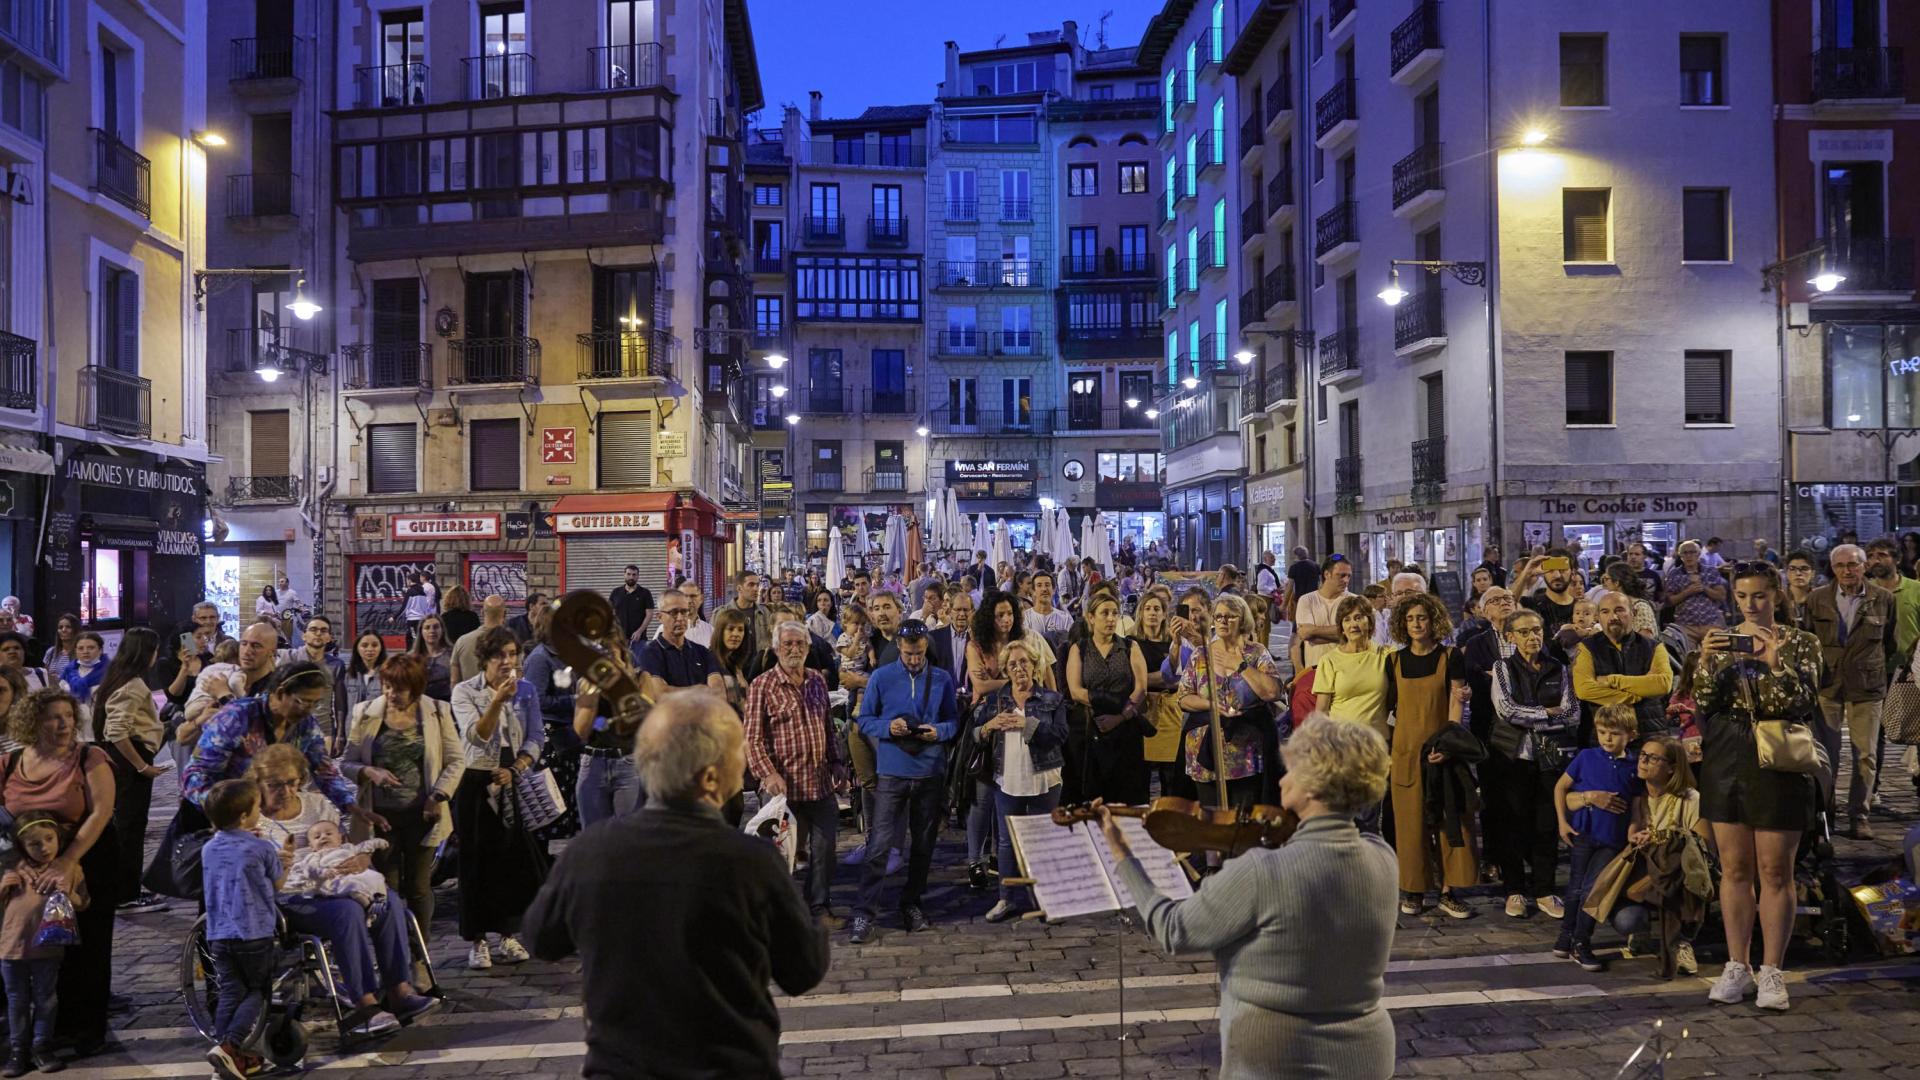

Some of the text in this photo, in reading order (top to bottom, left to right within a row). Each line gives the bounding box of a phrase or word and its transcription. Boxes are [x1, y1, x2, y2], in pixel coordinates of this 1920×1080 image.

[996, 461, 1029, 471] FERMÍN!
[66, 459, 194, 494] JAMONES Y EMBUTIDOS
[1799, 486, 1896, 497] GUTIERREZ
[1541, 497, 1698, 515] The Cookie Shop
[572, 515, 650, 528] GUTIERREZ
[1375, 510, 1436, 526] The Cookie Shop
[409, 520, 484, 533] GUTIERREZ
[158, 530, 190, 543] VIANDAS
[156, 542, 200, 555] SALAMANCA
